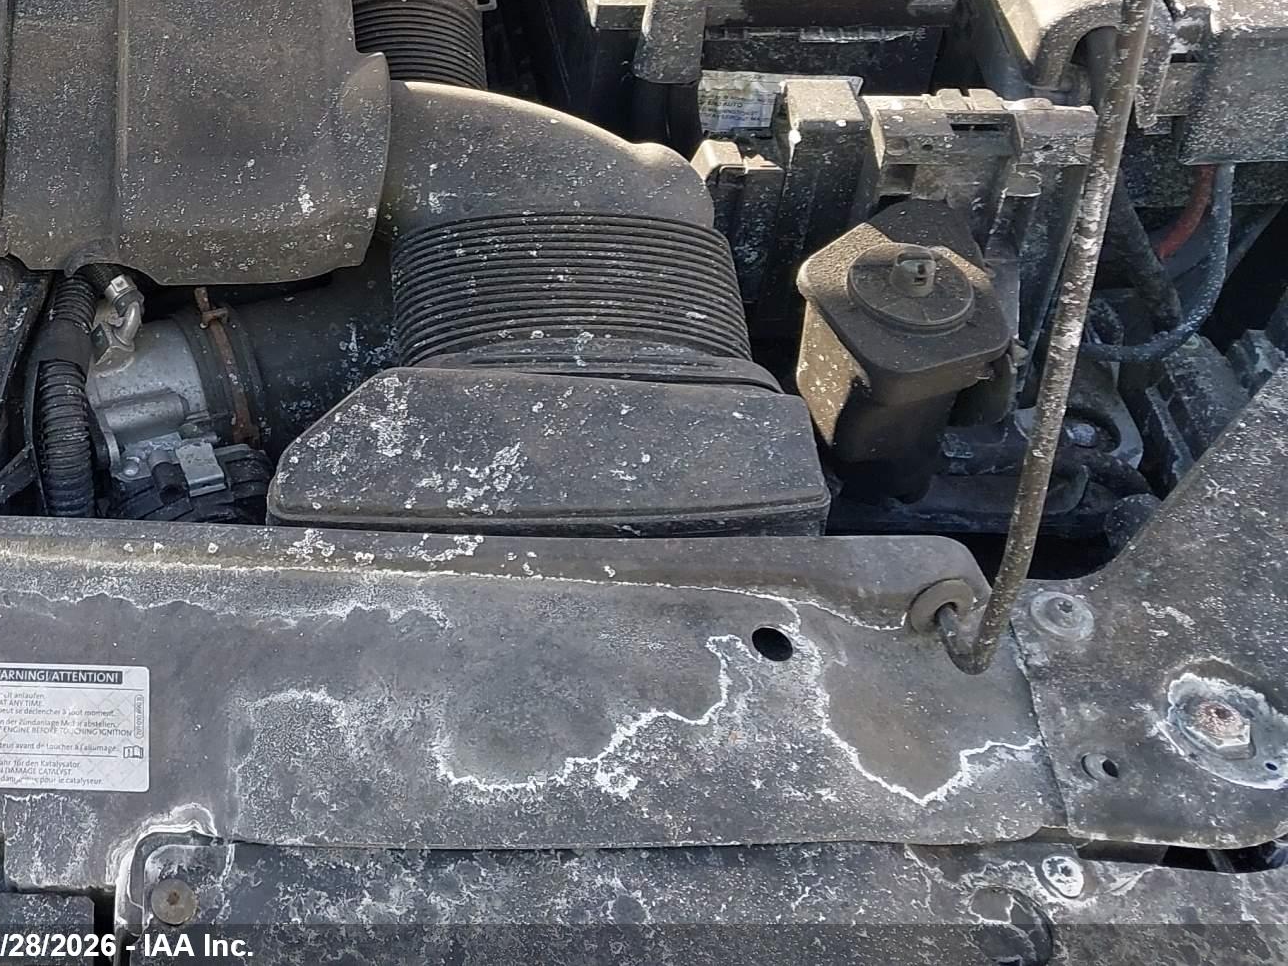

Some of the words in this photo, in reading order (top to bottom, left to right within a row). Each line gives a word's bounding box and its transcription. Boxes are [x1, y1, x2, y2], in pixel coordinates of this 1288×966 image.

[51, 671, 119, 683] ATTENTION!
[4, 726, 30, 734] ENGINE
[40, 777, 56, 785] pour
